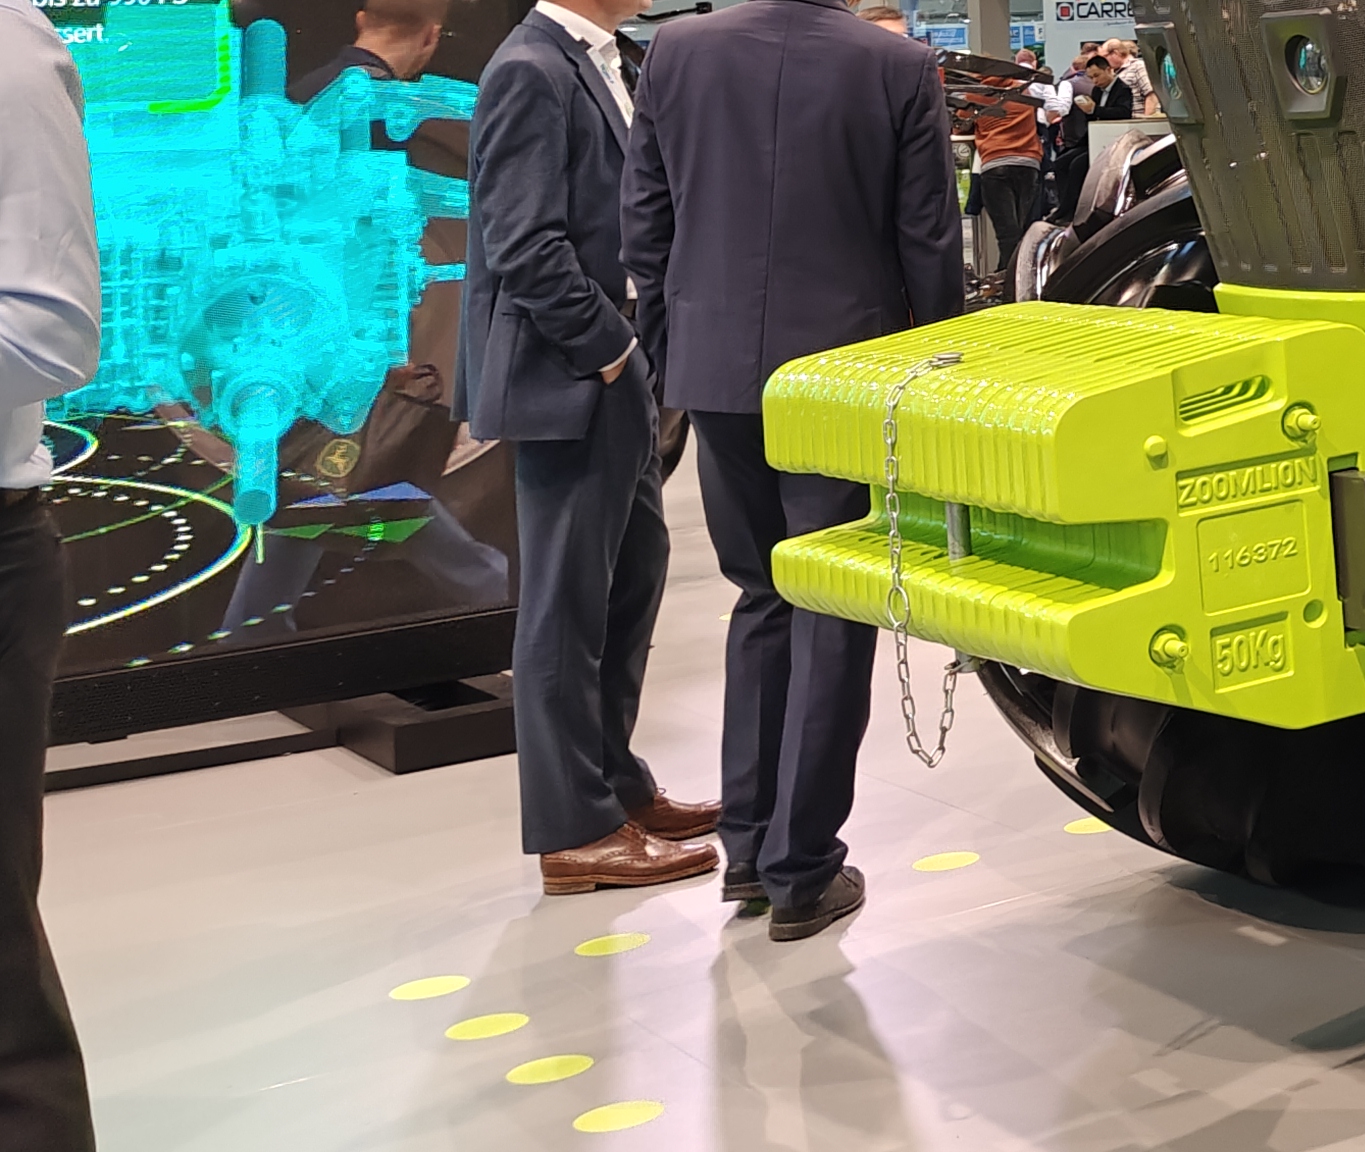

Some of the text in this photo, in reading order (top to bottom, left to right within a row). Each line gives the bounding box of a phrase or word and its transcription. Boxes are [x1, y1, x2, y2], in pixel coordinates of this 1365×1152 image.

[1176, 455, 1319, 508] ZOOMLION
[1206, 536, 1299, 574] 116372
[1215, 628, 1287, 676] 50Kg
